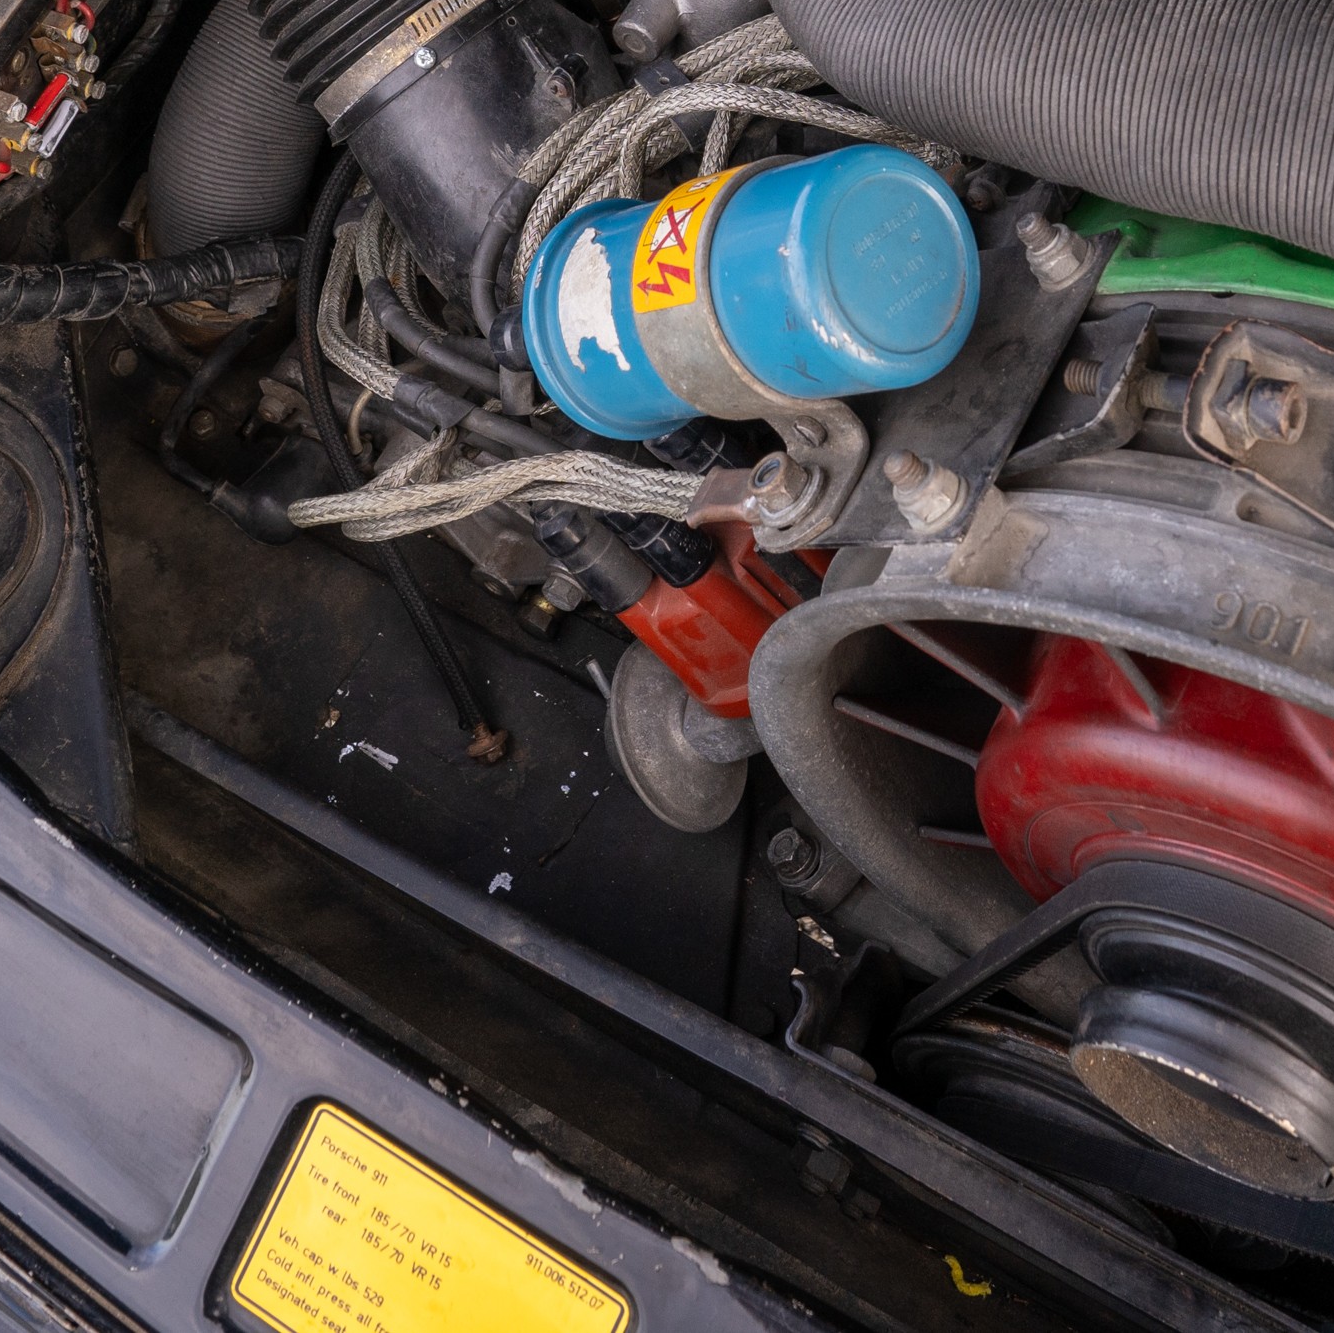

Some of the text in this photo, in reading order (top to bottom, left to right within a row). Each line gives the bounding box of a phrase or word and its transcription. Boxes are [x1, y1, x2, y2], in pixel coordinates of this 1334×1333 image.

[1209, 588, 1315, 657] 901
[321, 1136, 388, 1186] Porsche 911
[309, 1165, 328, 1185] Tire
[333, 1182, 359, 1206] front
[421, 1240, 437, 1258] VR
[439, 1252, 452, 1268] 15
[322, 1206, 347, 1225] rear
[412, 1262, 427, 1280] VR
[429, 1274, 442, 1290] 15
[257, 1269, 319, 1318] Designated
[267, 1249, 293, 1272] Cold
[357, 1314, 372, 1327] all
[363, 1286, 384, 1307] 529
[526, 1254, 605, 1310] 911.006.512.07
